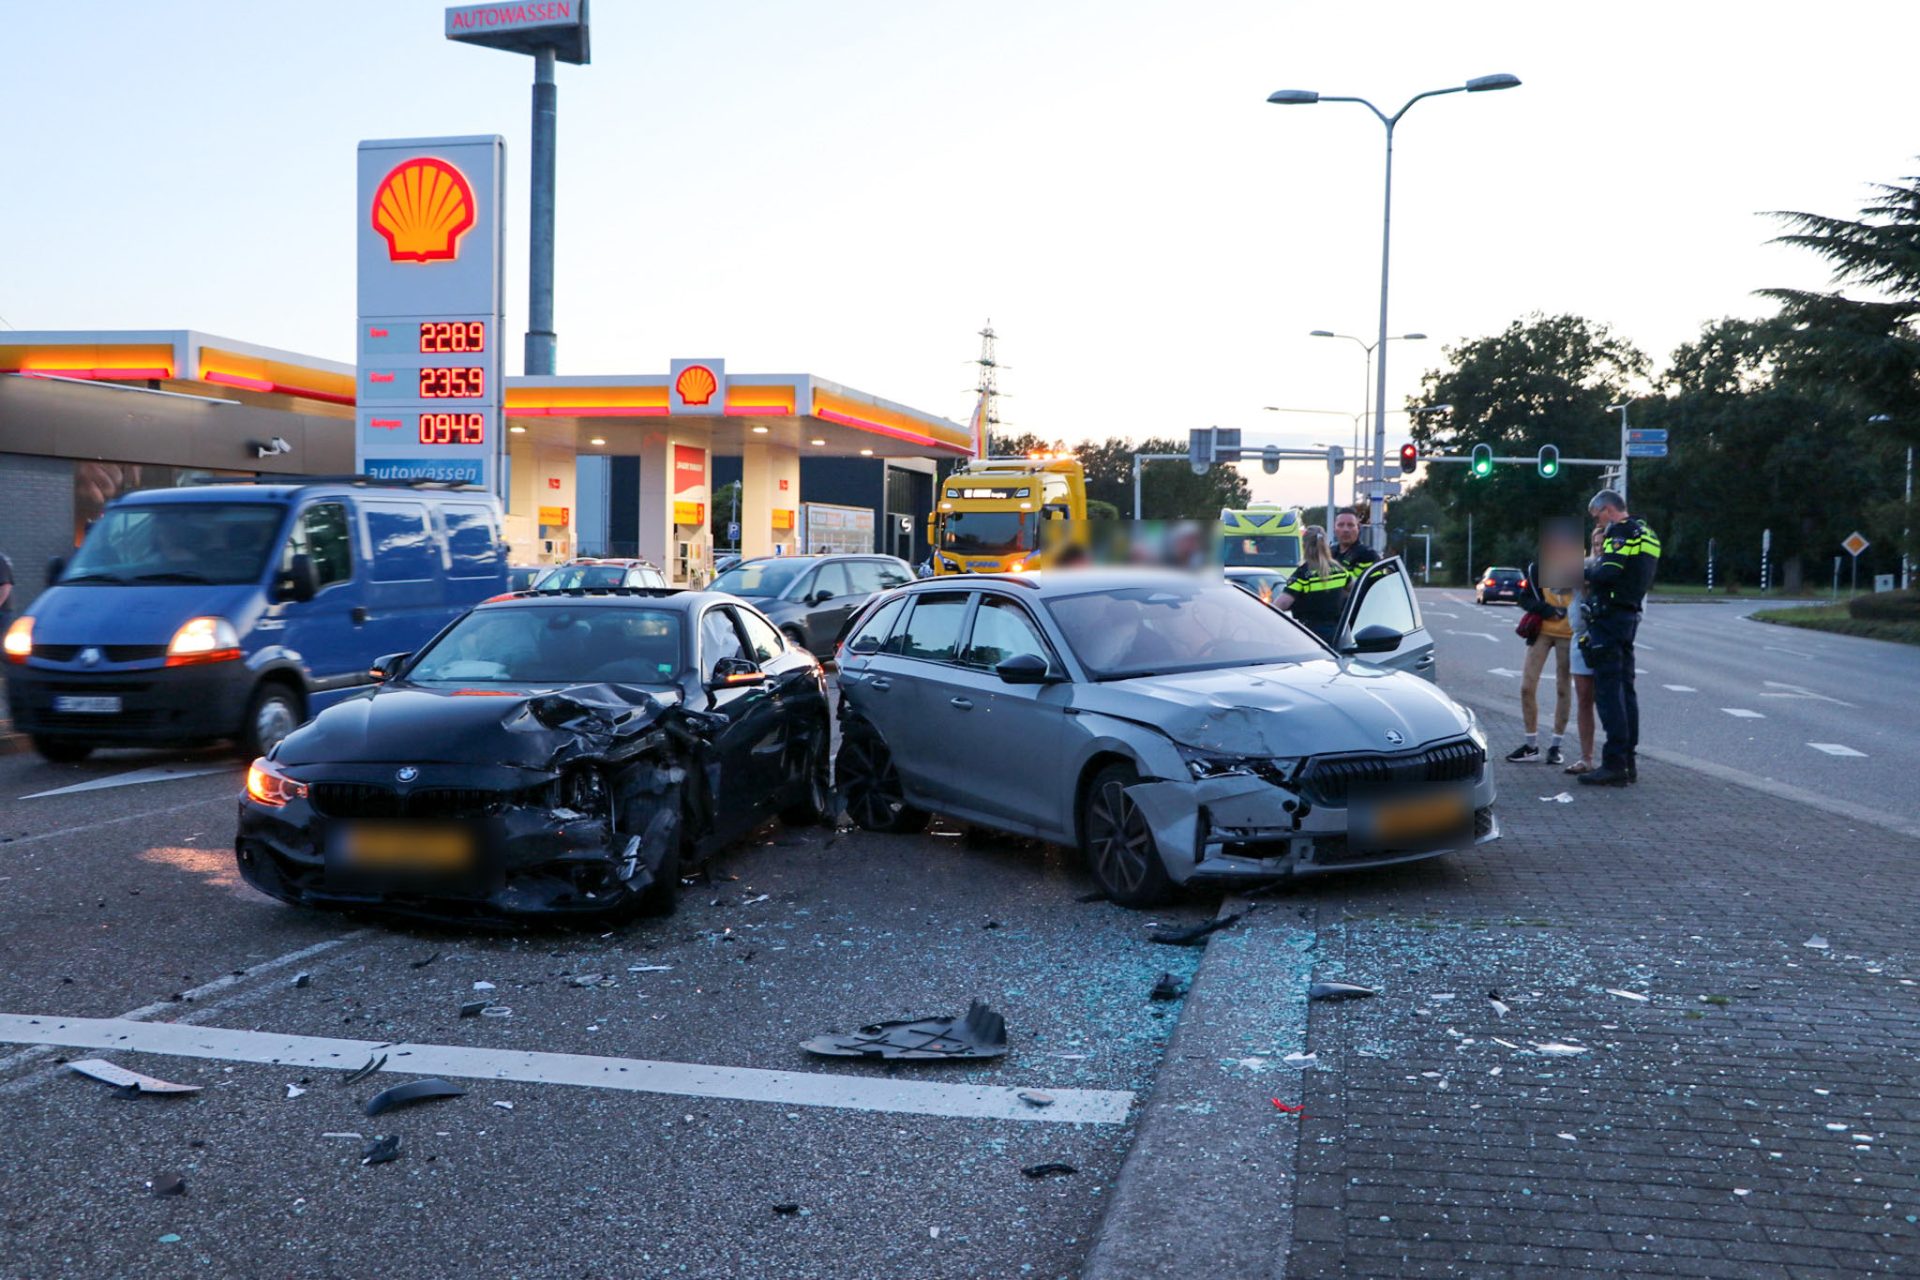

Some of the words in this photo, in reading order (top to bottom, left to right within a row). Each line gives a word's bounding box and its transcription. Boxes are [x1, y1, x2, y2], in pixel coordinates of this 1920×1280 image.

[452, 1, 570, 29] AUTOWASSEN
[420, 322, 484, 353] 228.9
[420, 368, 484, 398] 235.9
[419, 413, 483, 444] 094.9
[369, 465, 477, 480] autowassen
